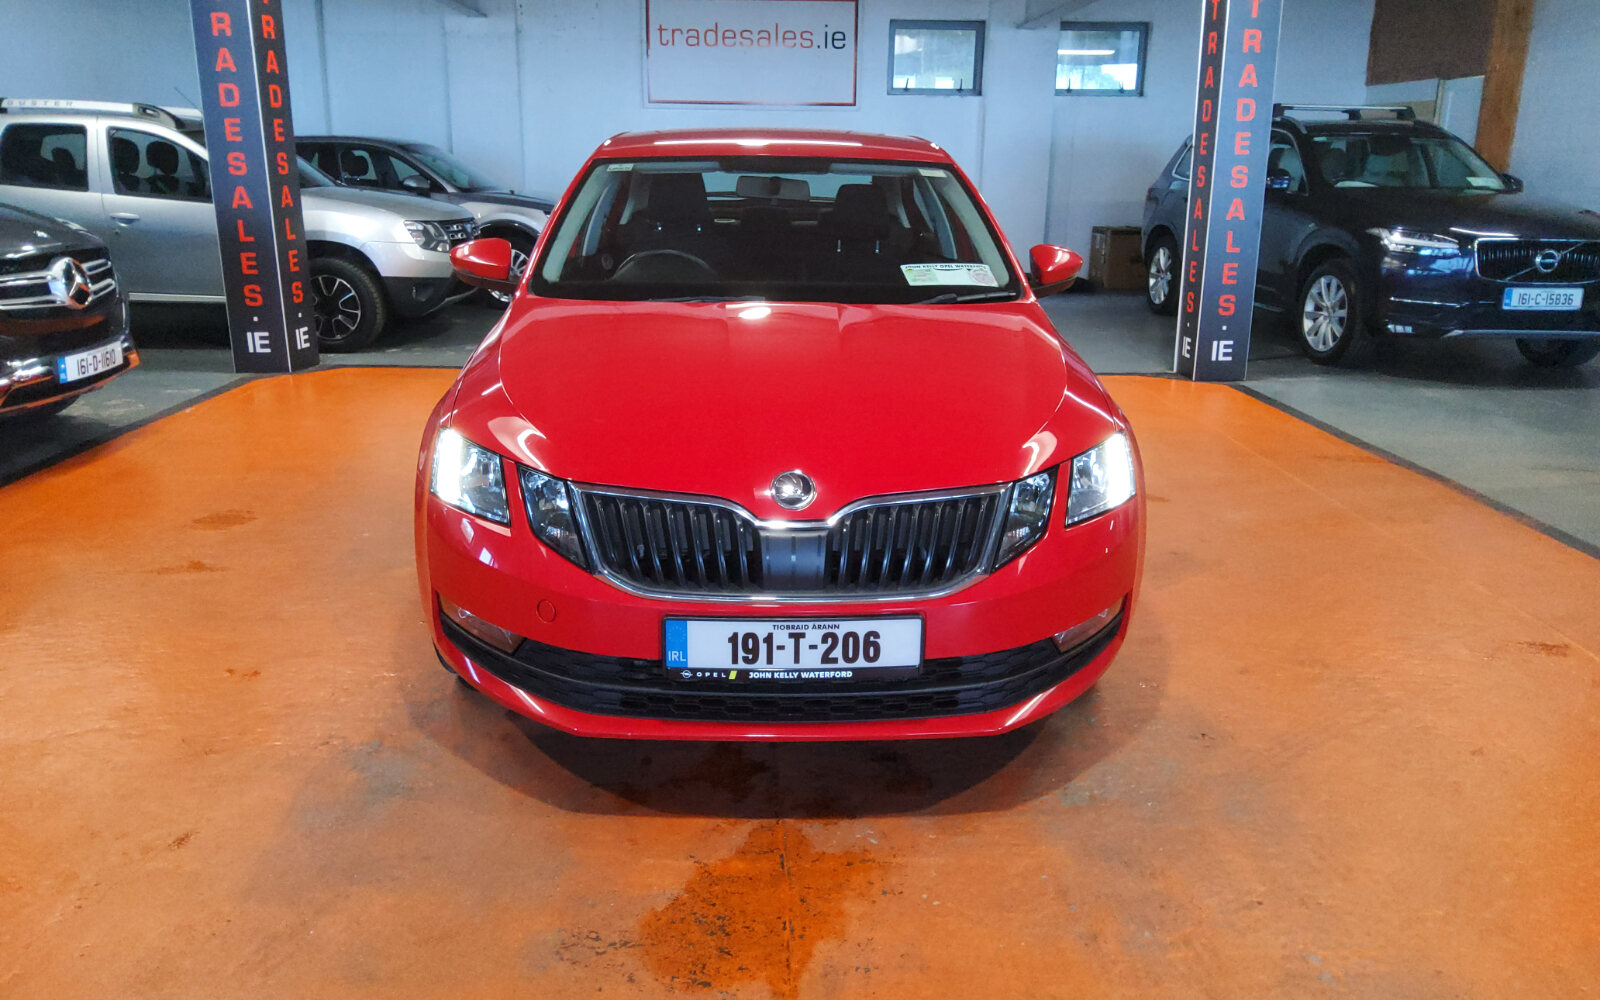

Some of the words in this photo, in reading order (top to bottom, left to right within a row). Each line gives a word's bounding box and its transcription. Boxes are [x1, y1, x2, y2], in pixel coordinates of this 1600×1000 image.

[657, 22, 846, 49] tradesales.ie
[667, 650, 687, 662] IRL
[727, 630, 882, 665] 191-T-206
[748, 671, 772, 679] JOHN
[773, 671, 799, 679] KELLY
[800, 671, 853, 679] WATERFORD
